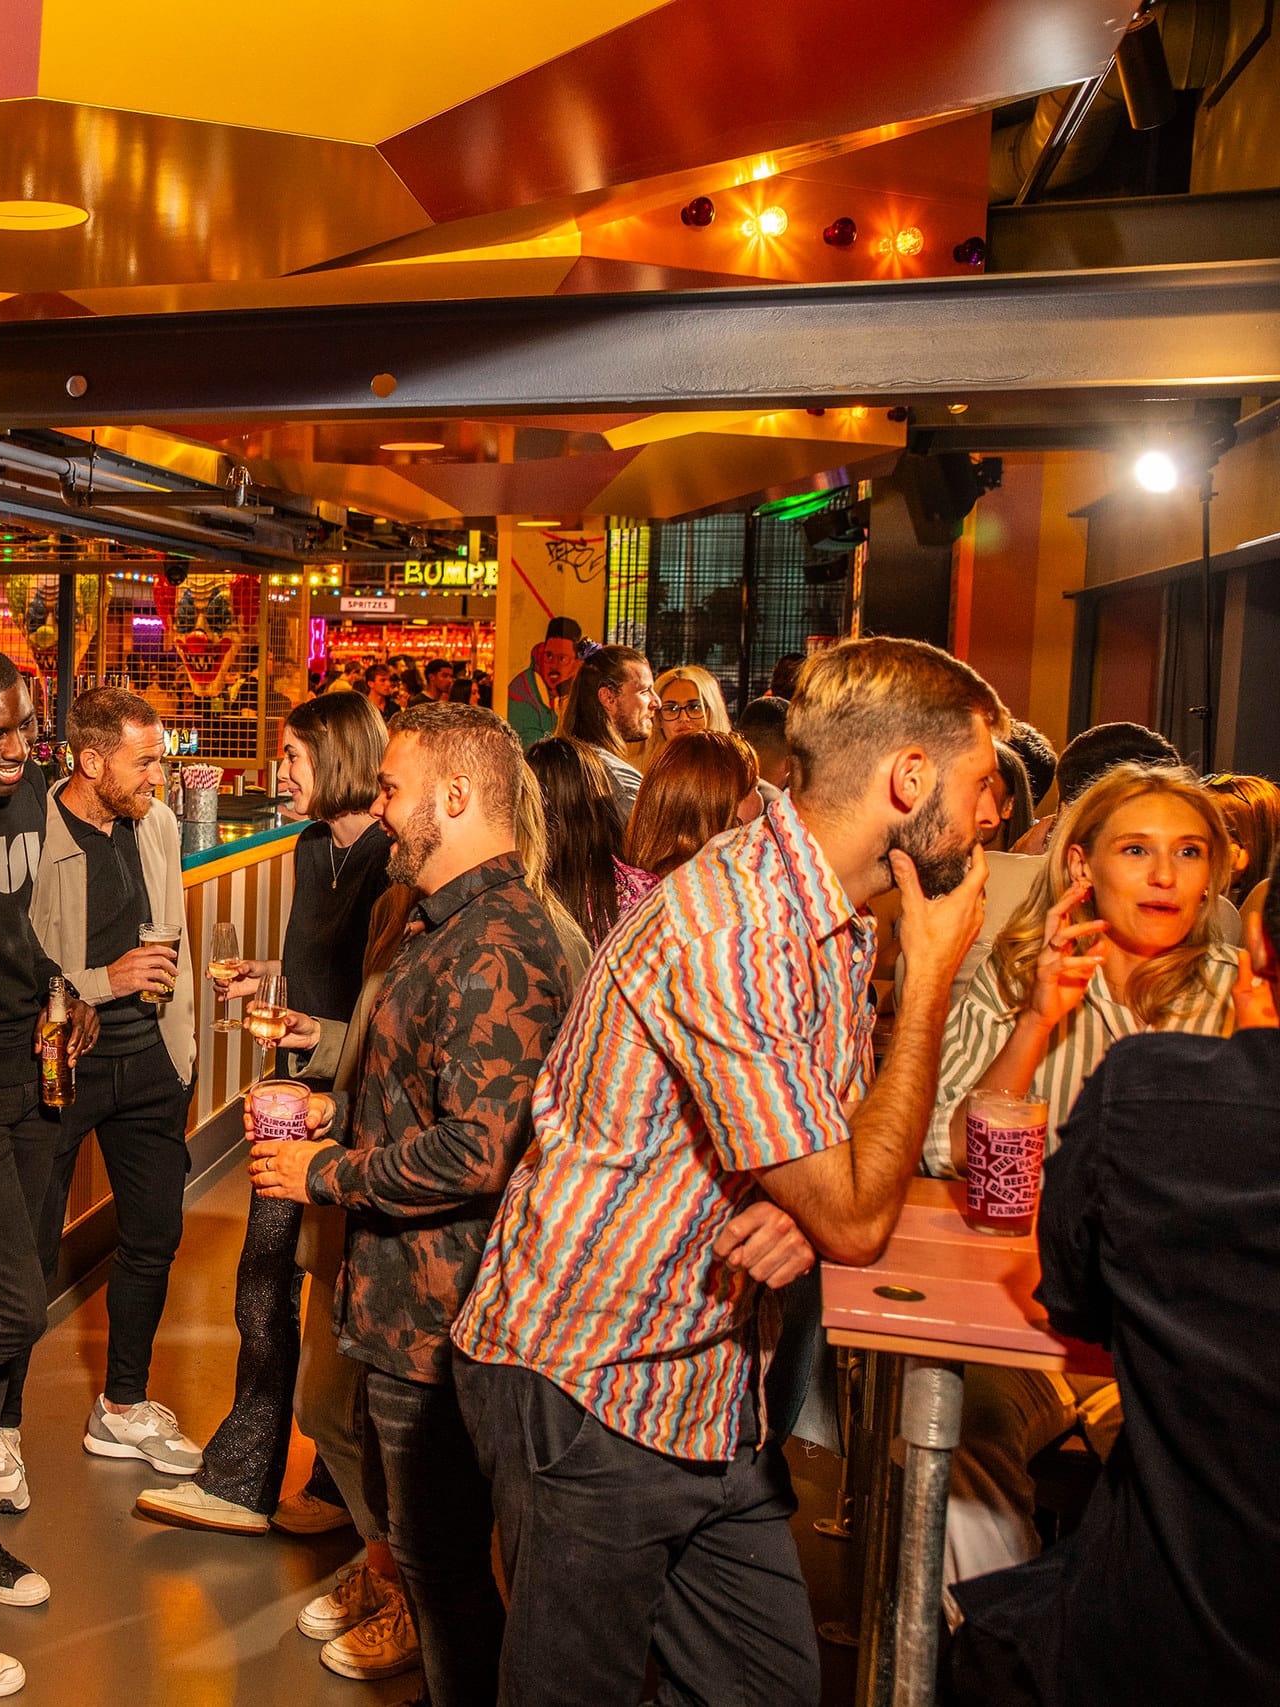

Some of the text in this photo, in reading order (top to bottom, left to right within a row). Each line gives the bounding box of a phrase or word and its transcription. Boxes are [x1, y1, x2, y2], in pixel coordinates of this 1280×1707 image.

[405, 560, 498, 585] BUMPE
[348, 601, 388, 609] SPRITZES
[264, 1127, 285, 1136] BEER
[991, 1125, 1047, 1141] FAIRGAM
[995, 1144, 1024, 1156] BEER
[992, 1156, 1013, 1173] BEE
[1004, 1175, 1029, 1187] BEER
[990, 1183, 1016, 1202] BEER
[990, 1204, 1035, 1215] FAIRGAM
